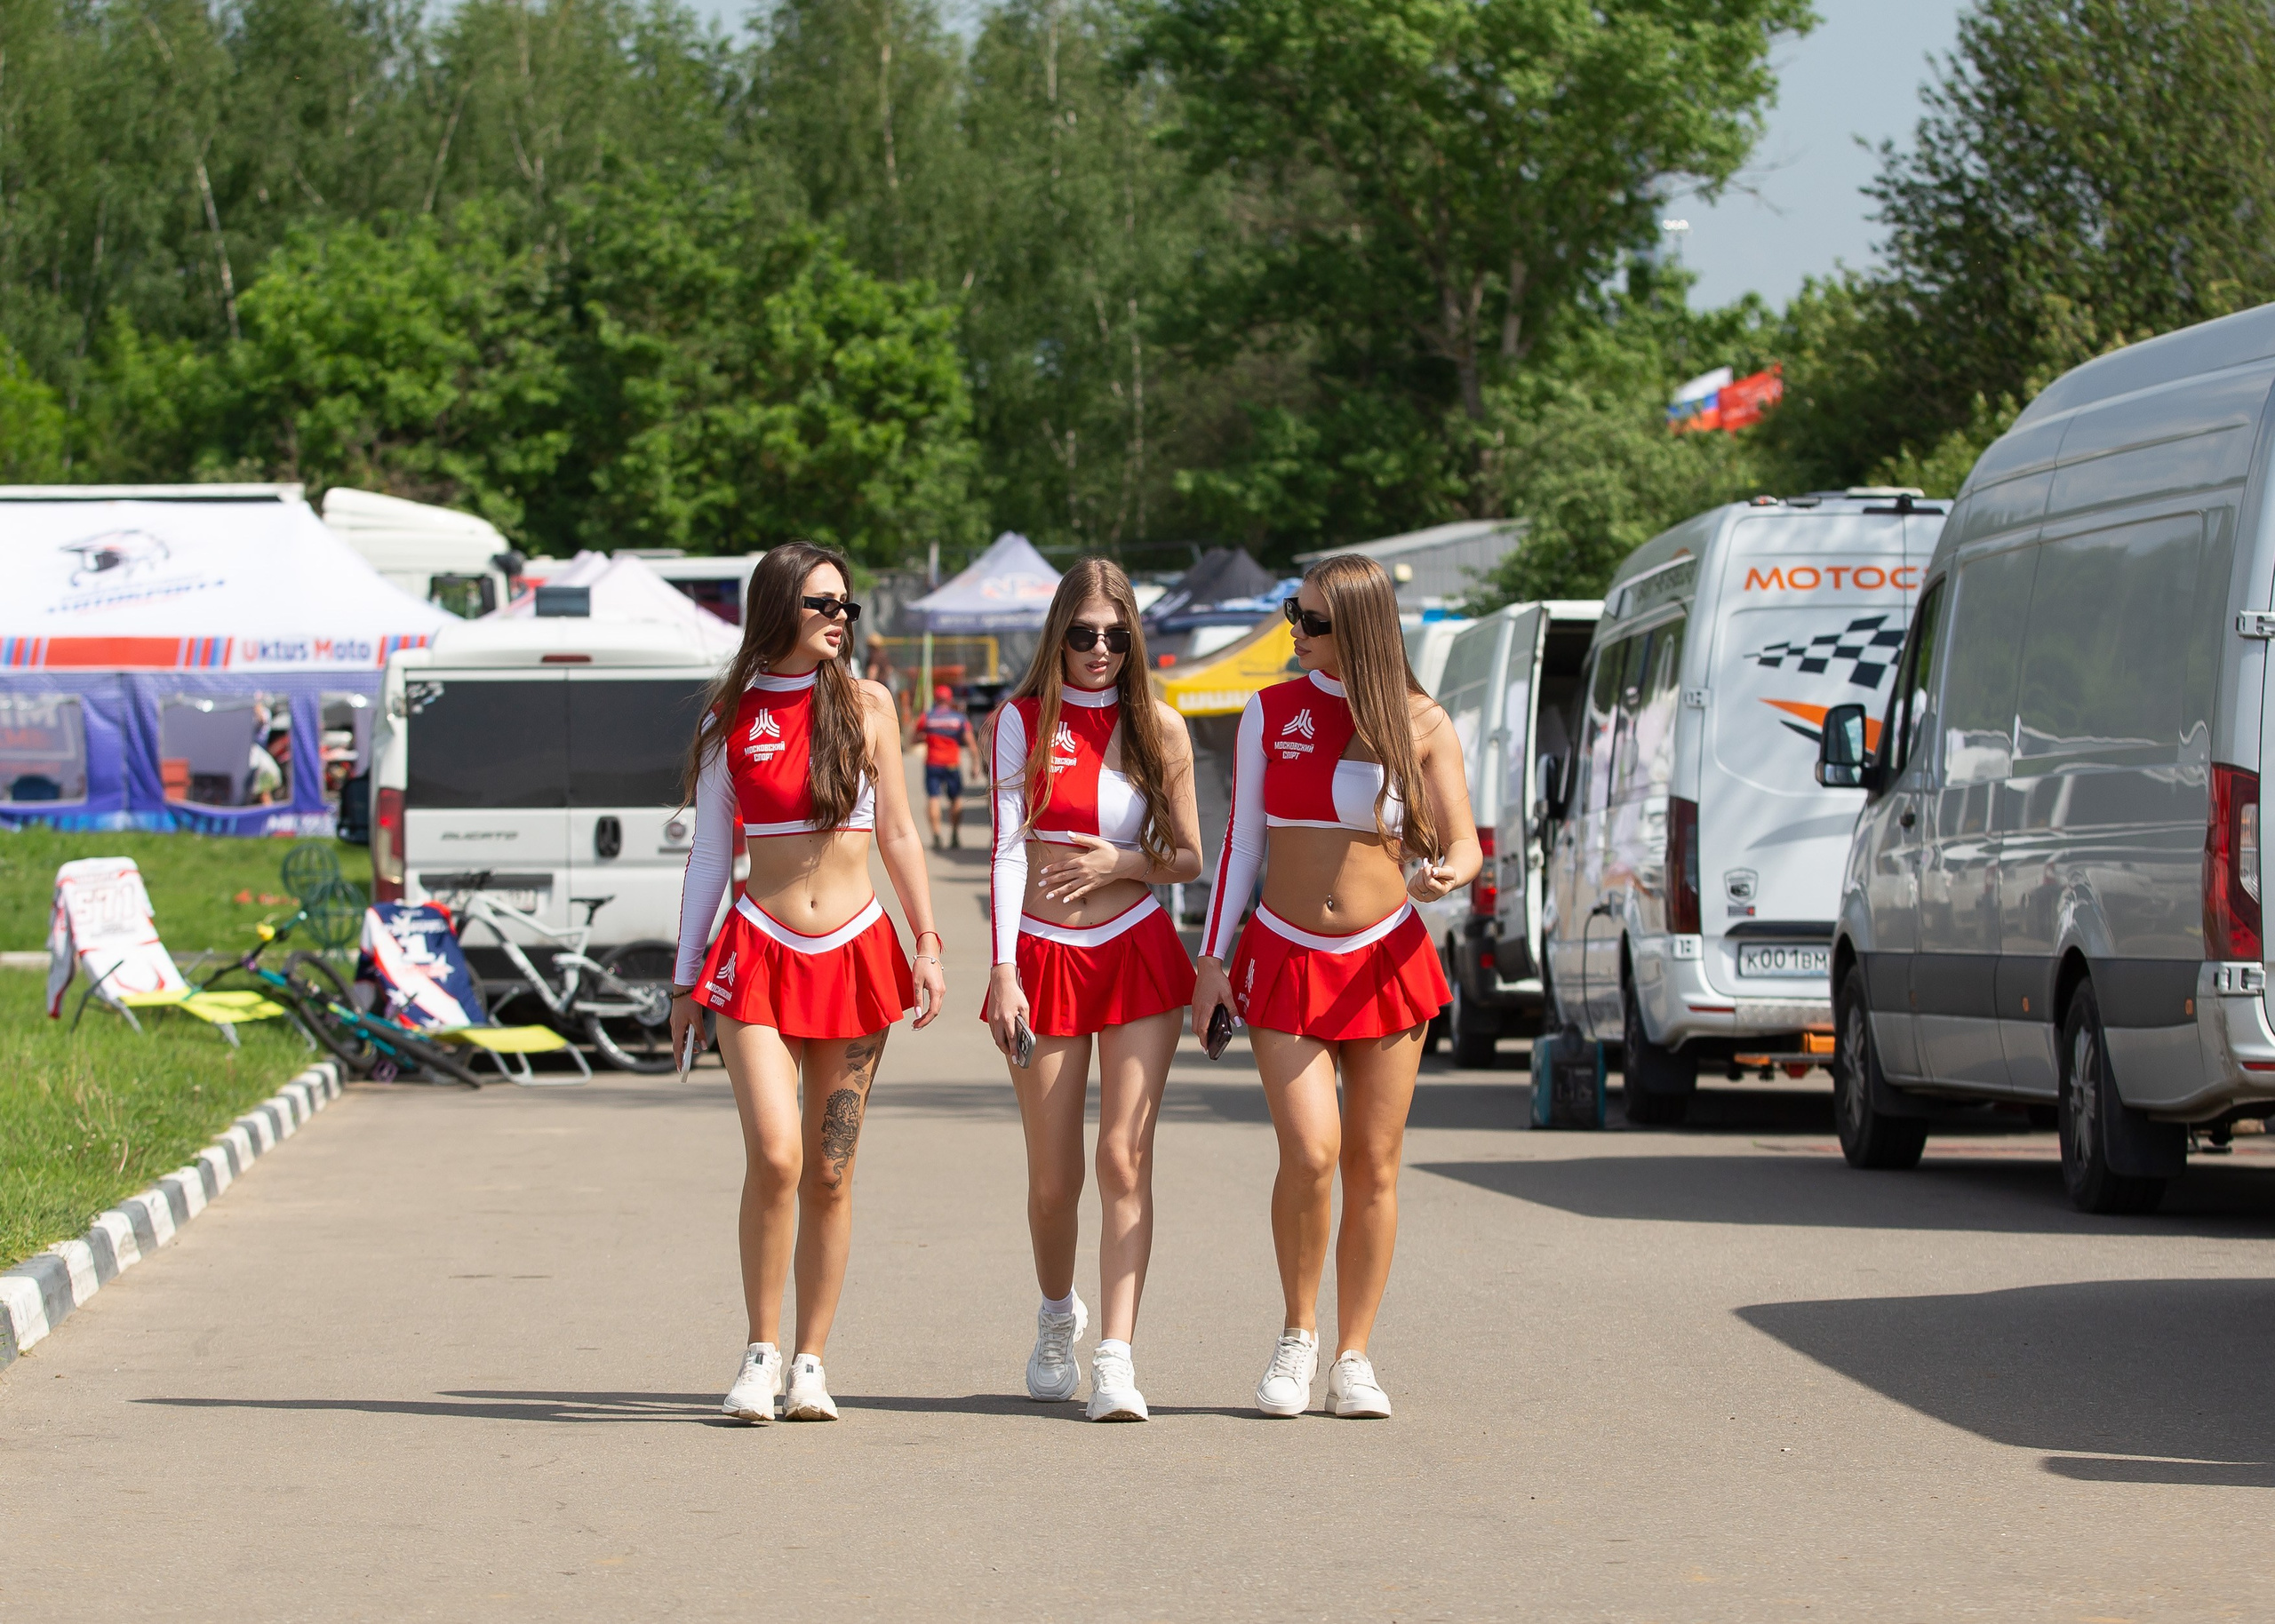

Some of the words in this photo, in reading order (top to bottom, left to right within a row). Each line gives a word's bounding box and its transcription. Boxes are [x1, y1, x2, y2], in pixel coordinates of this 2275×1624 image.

[1744, 566, 1929, 591] МОТОС
[243, 639, 307, 662] Uktus
[314, 638, 371, 661] Moto
[744, 740, 786, 756] МОСКОВСКИЙ
[1274, 741, 1314, 753] МОСКОВСКИЙ
[754, 752, 774, 762] СПОРТ
[1282, 751, 1300, 760] СПОРТ
